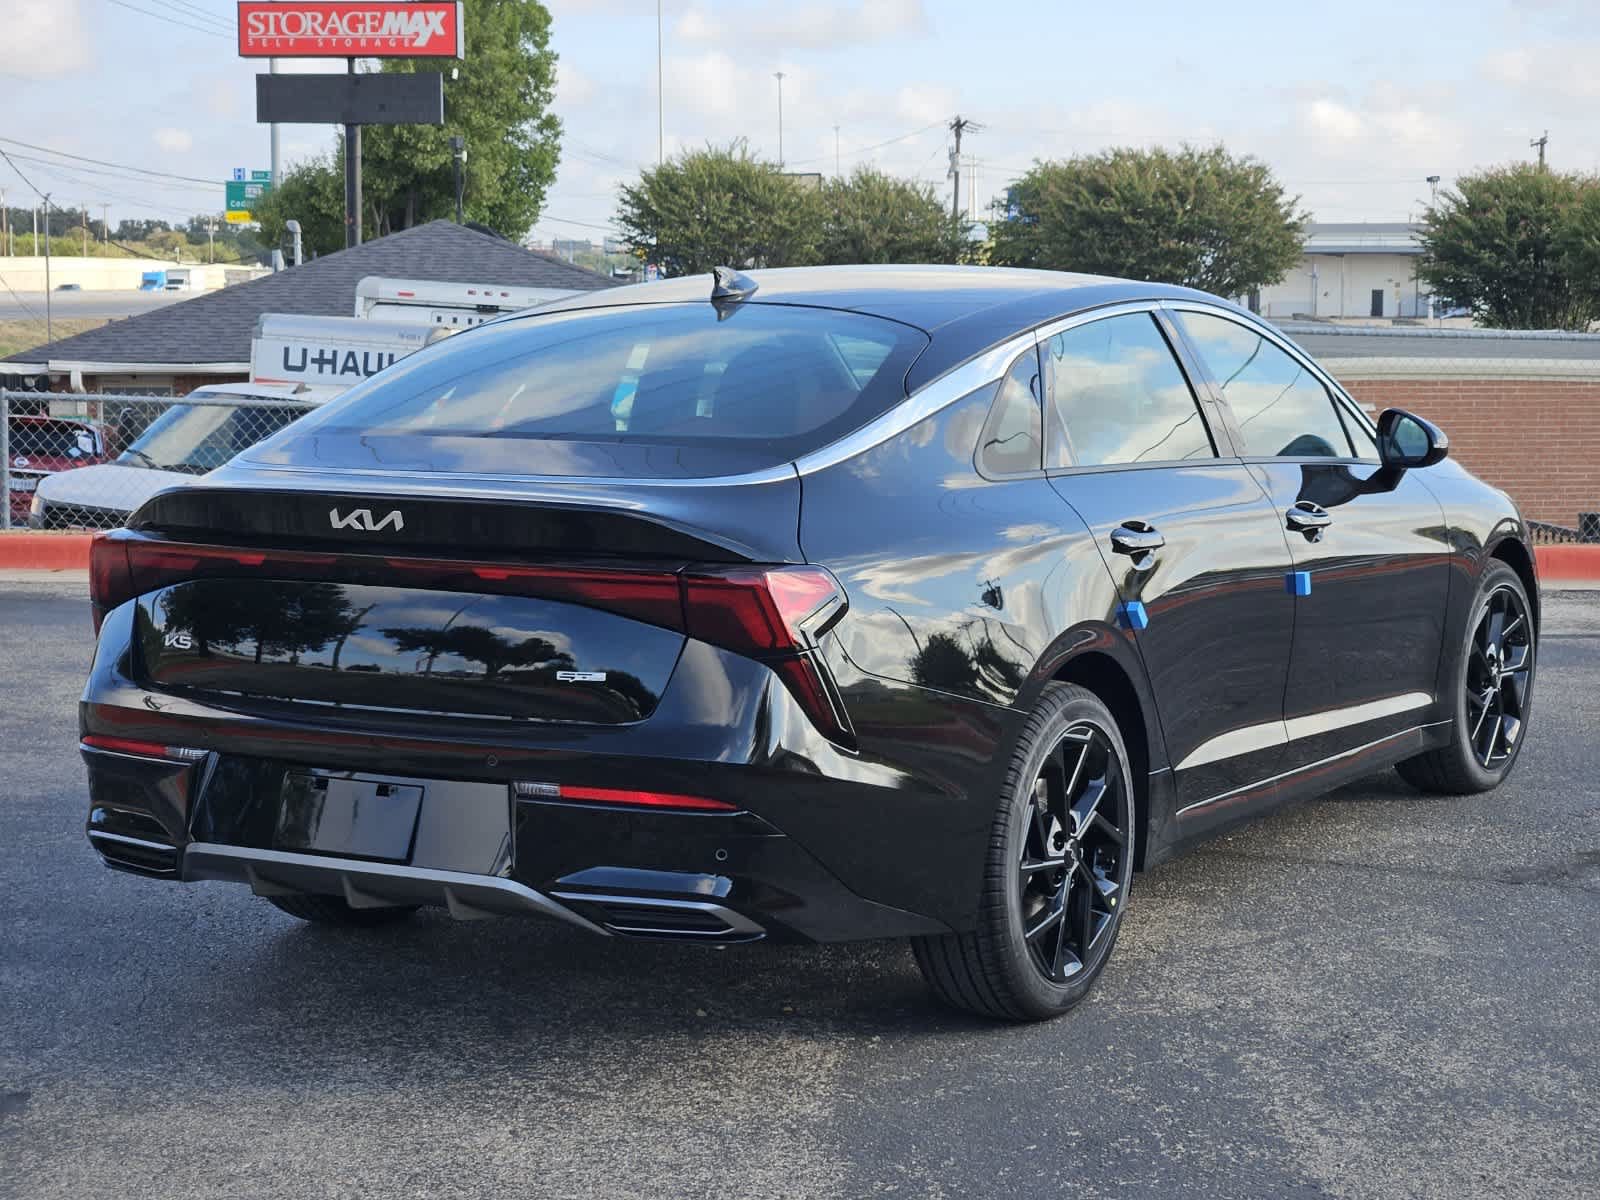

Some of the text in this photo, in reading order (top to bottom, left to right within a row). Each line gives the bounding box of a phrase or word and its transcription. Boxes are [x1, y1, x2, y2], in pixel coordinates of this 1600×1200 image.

[248, 38, 411, 47] SELF STORAGE
[330, 507, 404, 532] KIA
